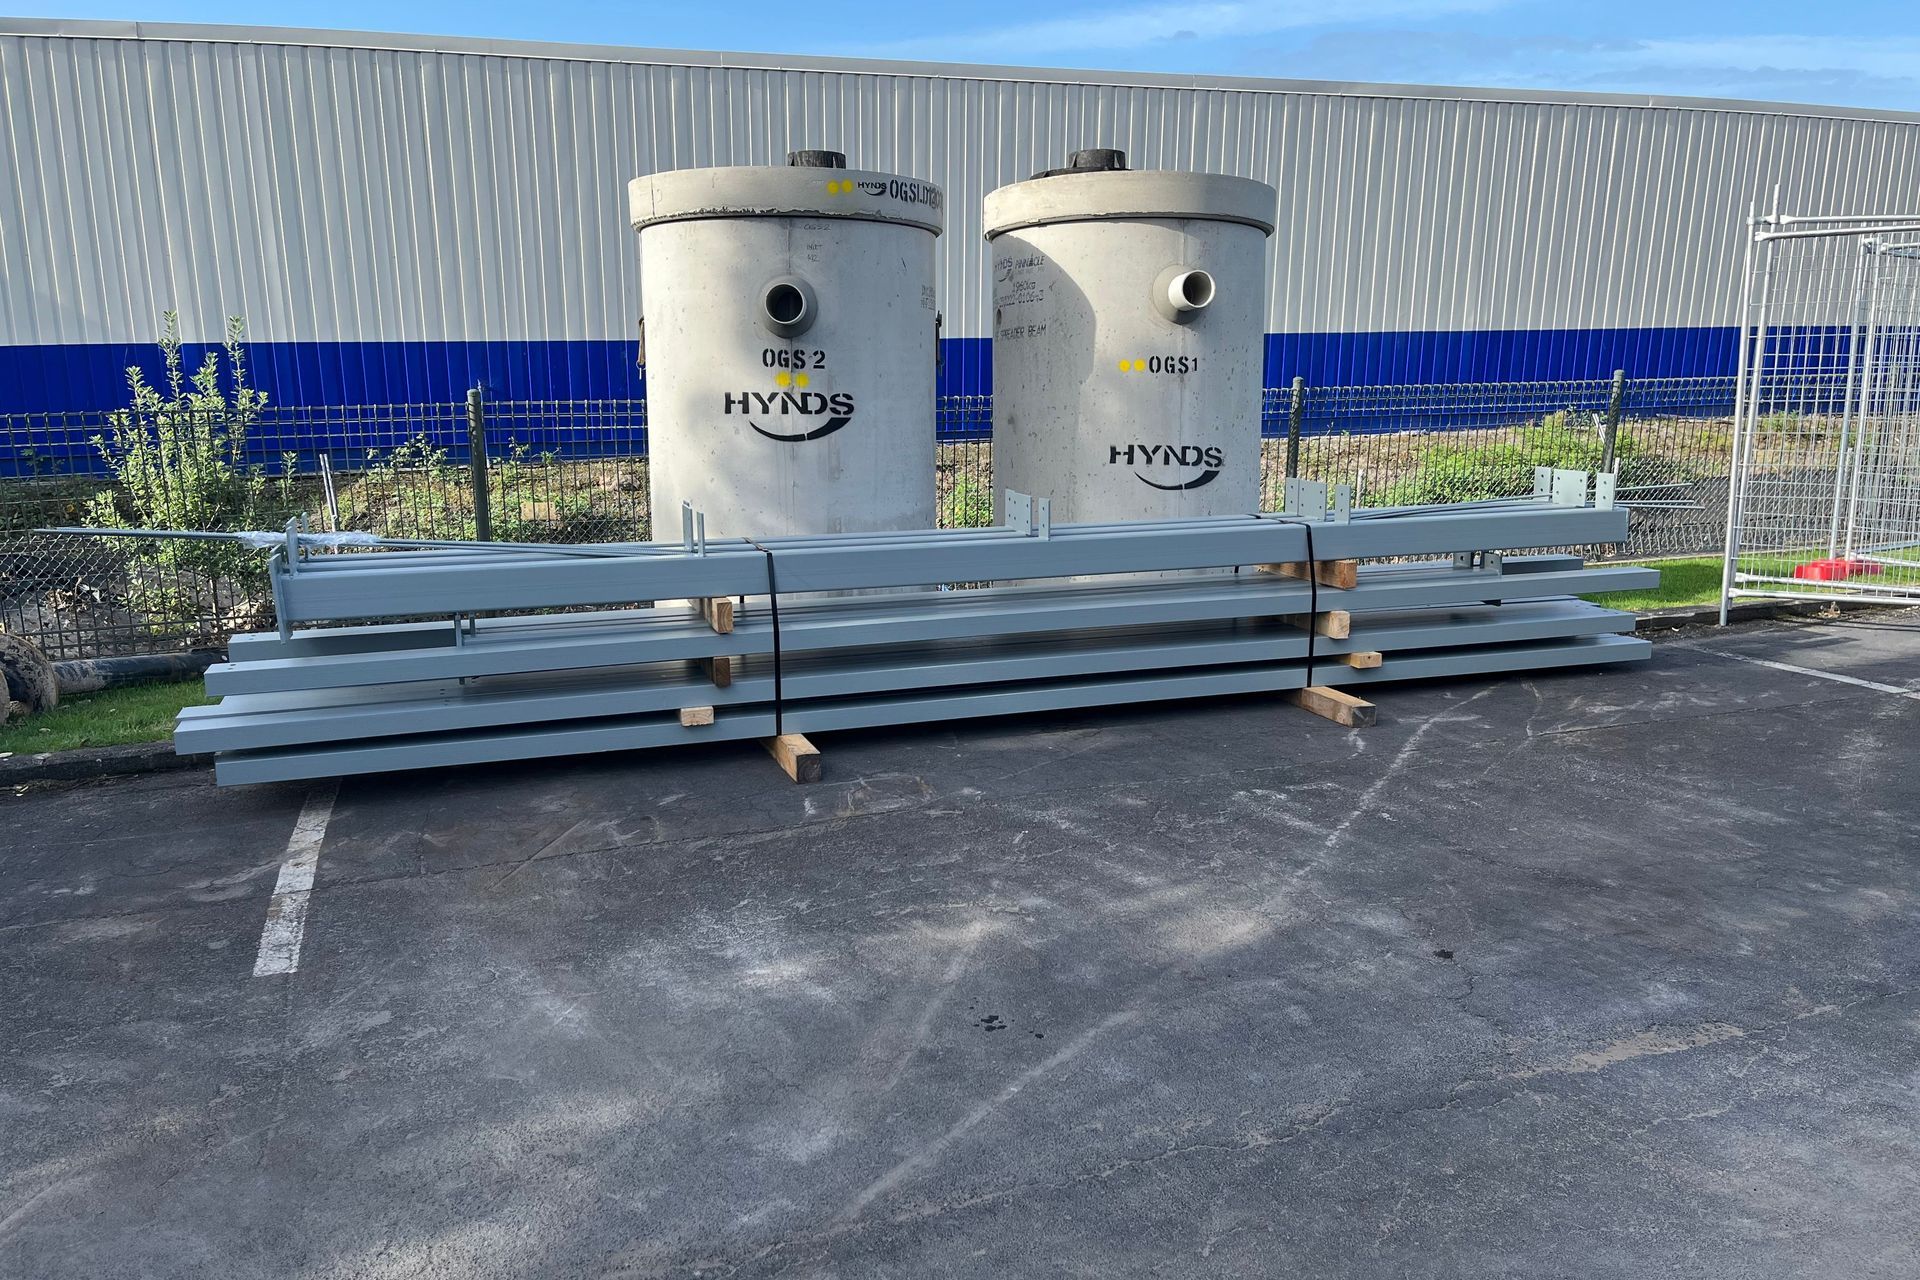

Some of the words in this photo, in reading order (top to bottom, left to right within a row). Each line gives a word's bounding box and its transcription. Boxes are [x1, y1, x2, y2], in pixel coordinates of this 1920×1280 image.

[857, 181, 887, 190] HYNDS
[762, 348, 806, 369] OGS
[813, 350, 826, 369] 2
[724, 391, 855, 416] HYNDS
[1109, 444, 1223, 468] HYNDS
